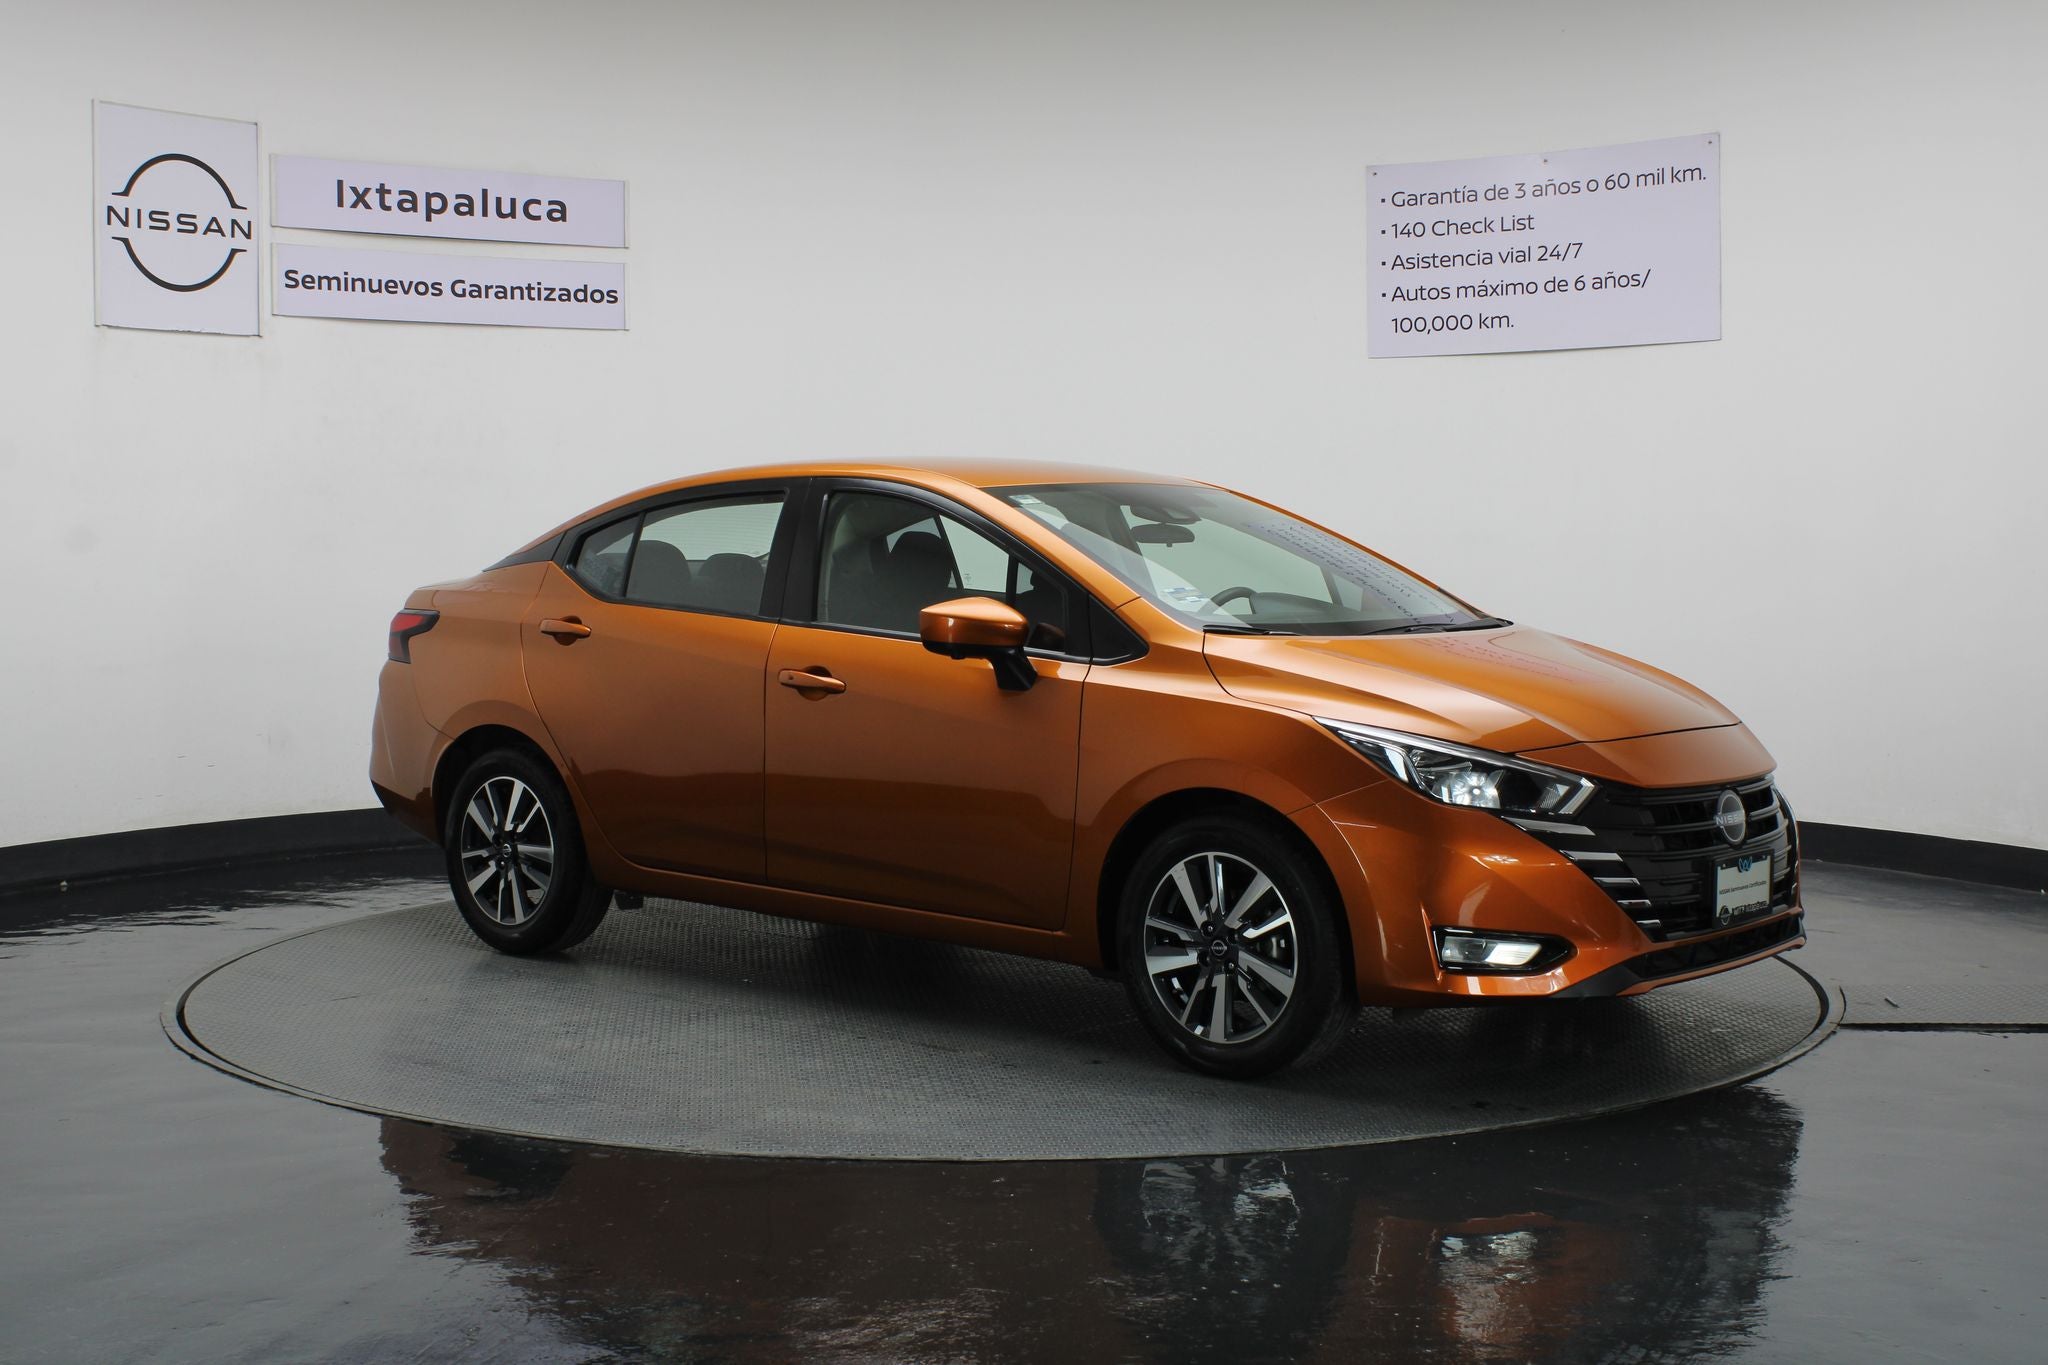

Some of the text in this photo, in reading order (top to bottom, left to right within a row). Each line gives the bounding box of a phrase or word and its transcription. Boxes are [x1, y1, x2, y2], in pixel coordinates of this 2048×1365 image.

[336, 179, 568, 223] Ixtapaluca
[1390, 165, 1707, 208] Garantía de 3 años o 60 mil km.
[106, 204, 252, 239] NISSAN
[1391, 213, 1535, 239] 140 Check List
[1390, 242, 1584, 271] Asistencia vial 24/7
[284, 269, 619, 305] Seminuevos Garantizados
[1391, 268, 1652, 303] Autos máximo de 6 años/
[1391, 312, 1515, 335] 100,000 km.
